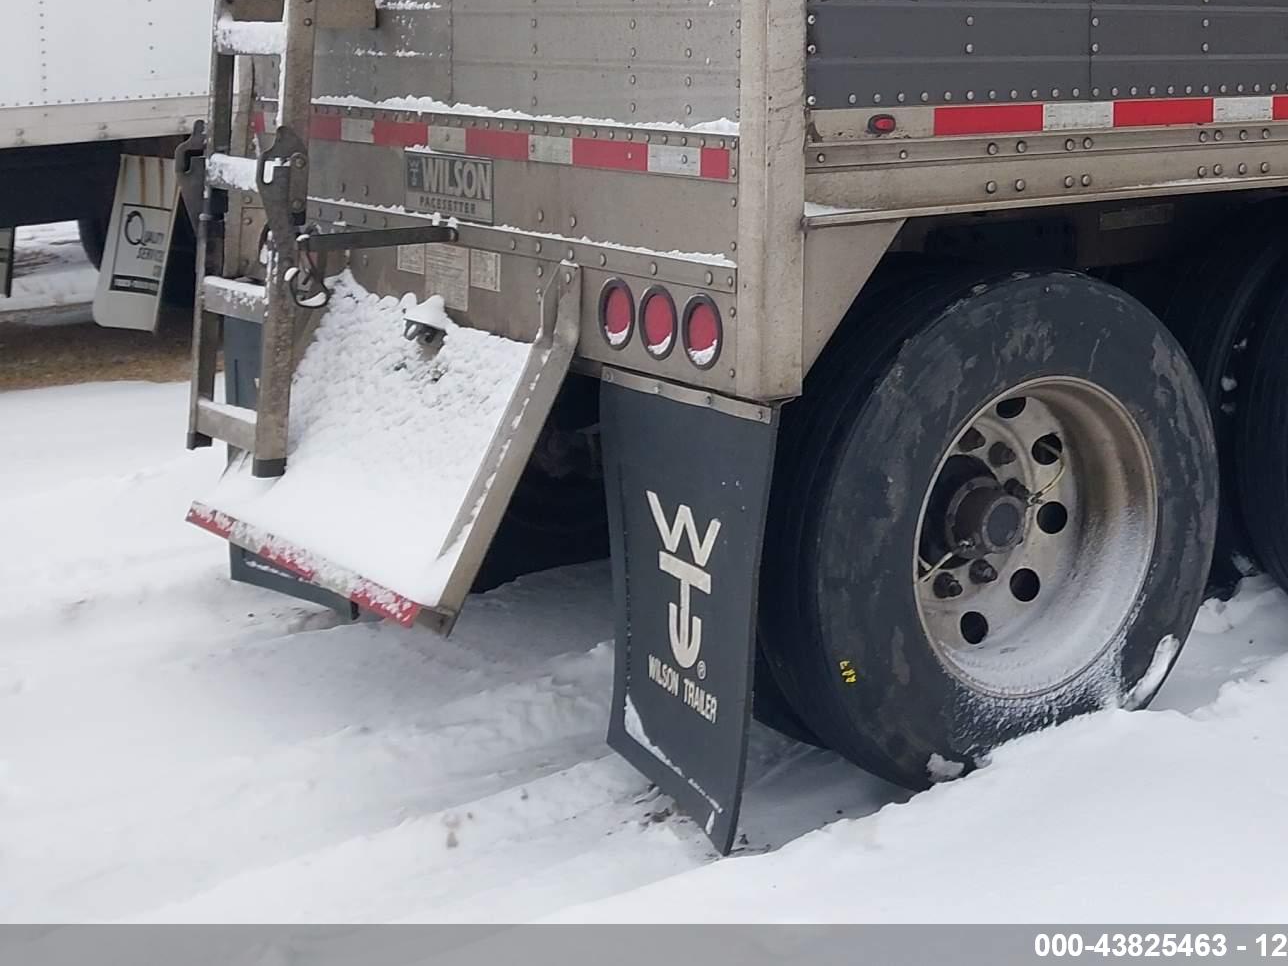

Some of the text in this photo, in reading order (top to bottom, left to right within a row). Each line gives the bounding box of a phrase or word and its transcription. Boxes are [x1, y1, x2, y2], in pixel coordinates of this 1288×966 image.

[423, 157, 491, 200] WILSON
[421, 197, 476, 214] PACESETTER
[648, 654, 718, 725] WILSON TRAILER
